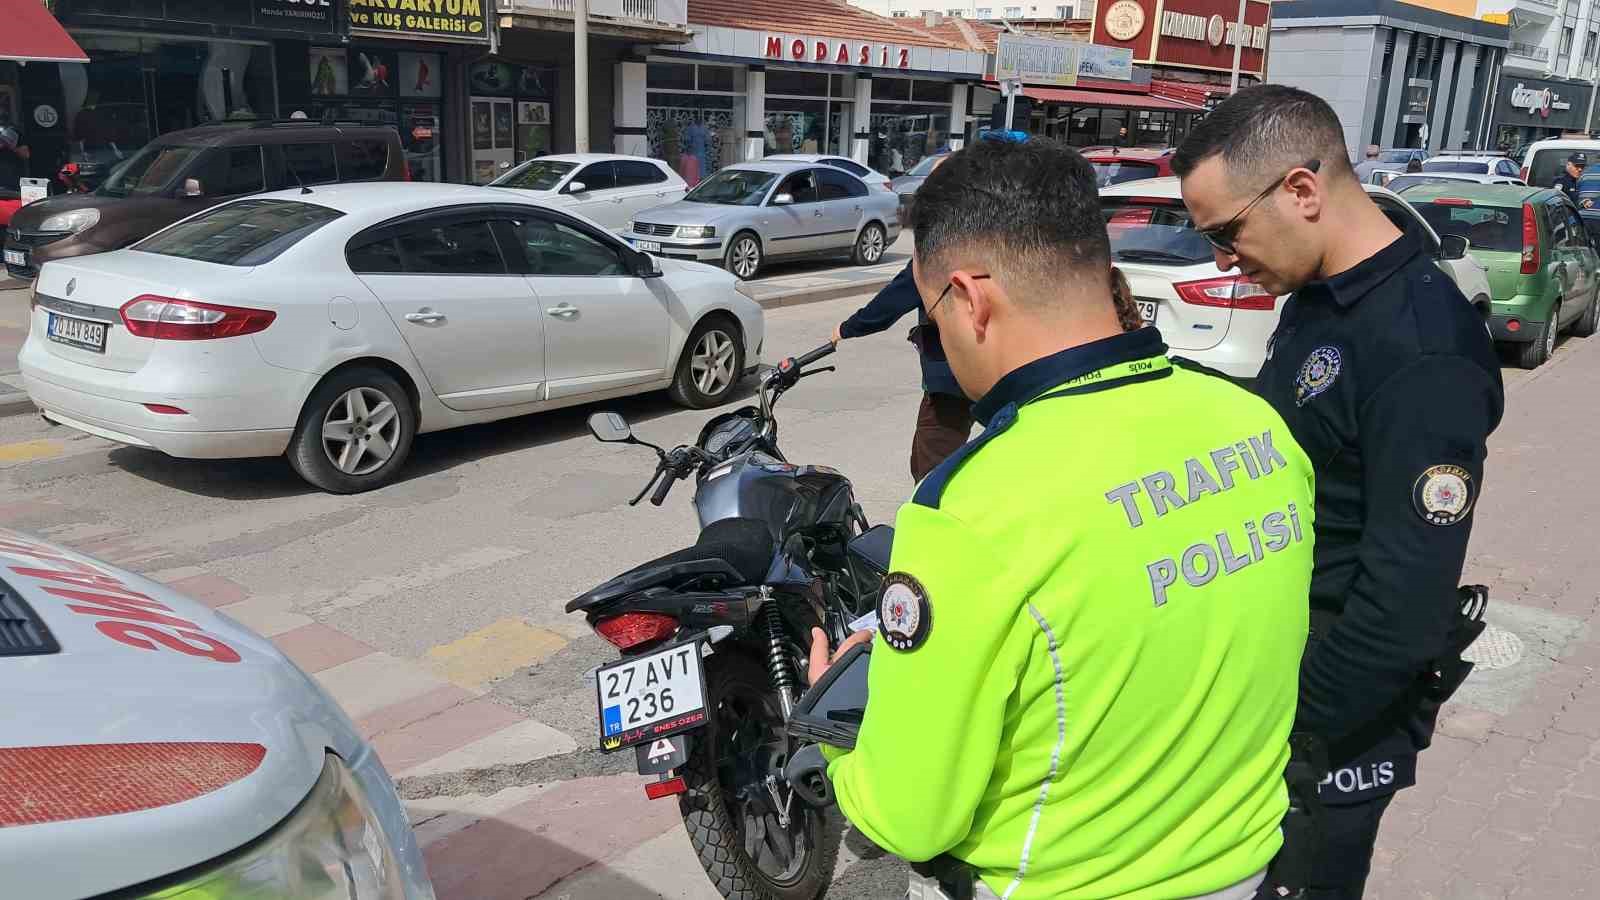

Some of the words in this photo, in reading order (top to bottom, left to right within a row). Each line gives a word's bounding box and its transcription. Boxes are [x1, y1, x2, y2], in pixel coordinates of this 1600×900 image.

[351, 13, 369, 24] ve
[373, 12, 402, 30] KUŞ
[65, 319, 81, 338] AAV
[83, 324, 102, 343] 849
[606, 666, 636, 699] 27
[645, 650, 690, 687] AVT
[627, 687, 674, 724] 236
[609, 722, 621, 732] TR
